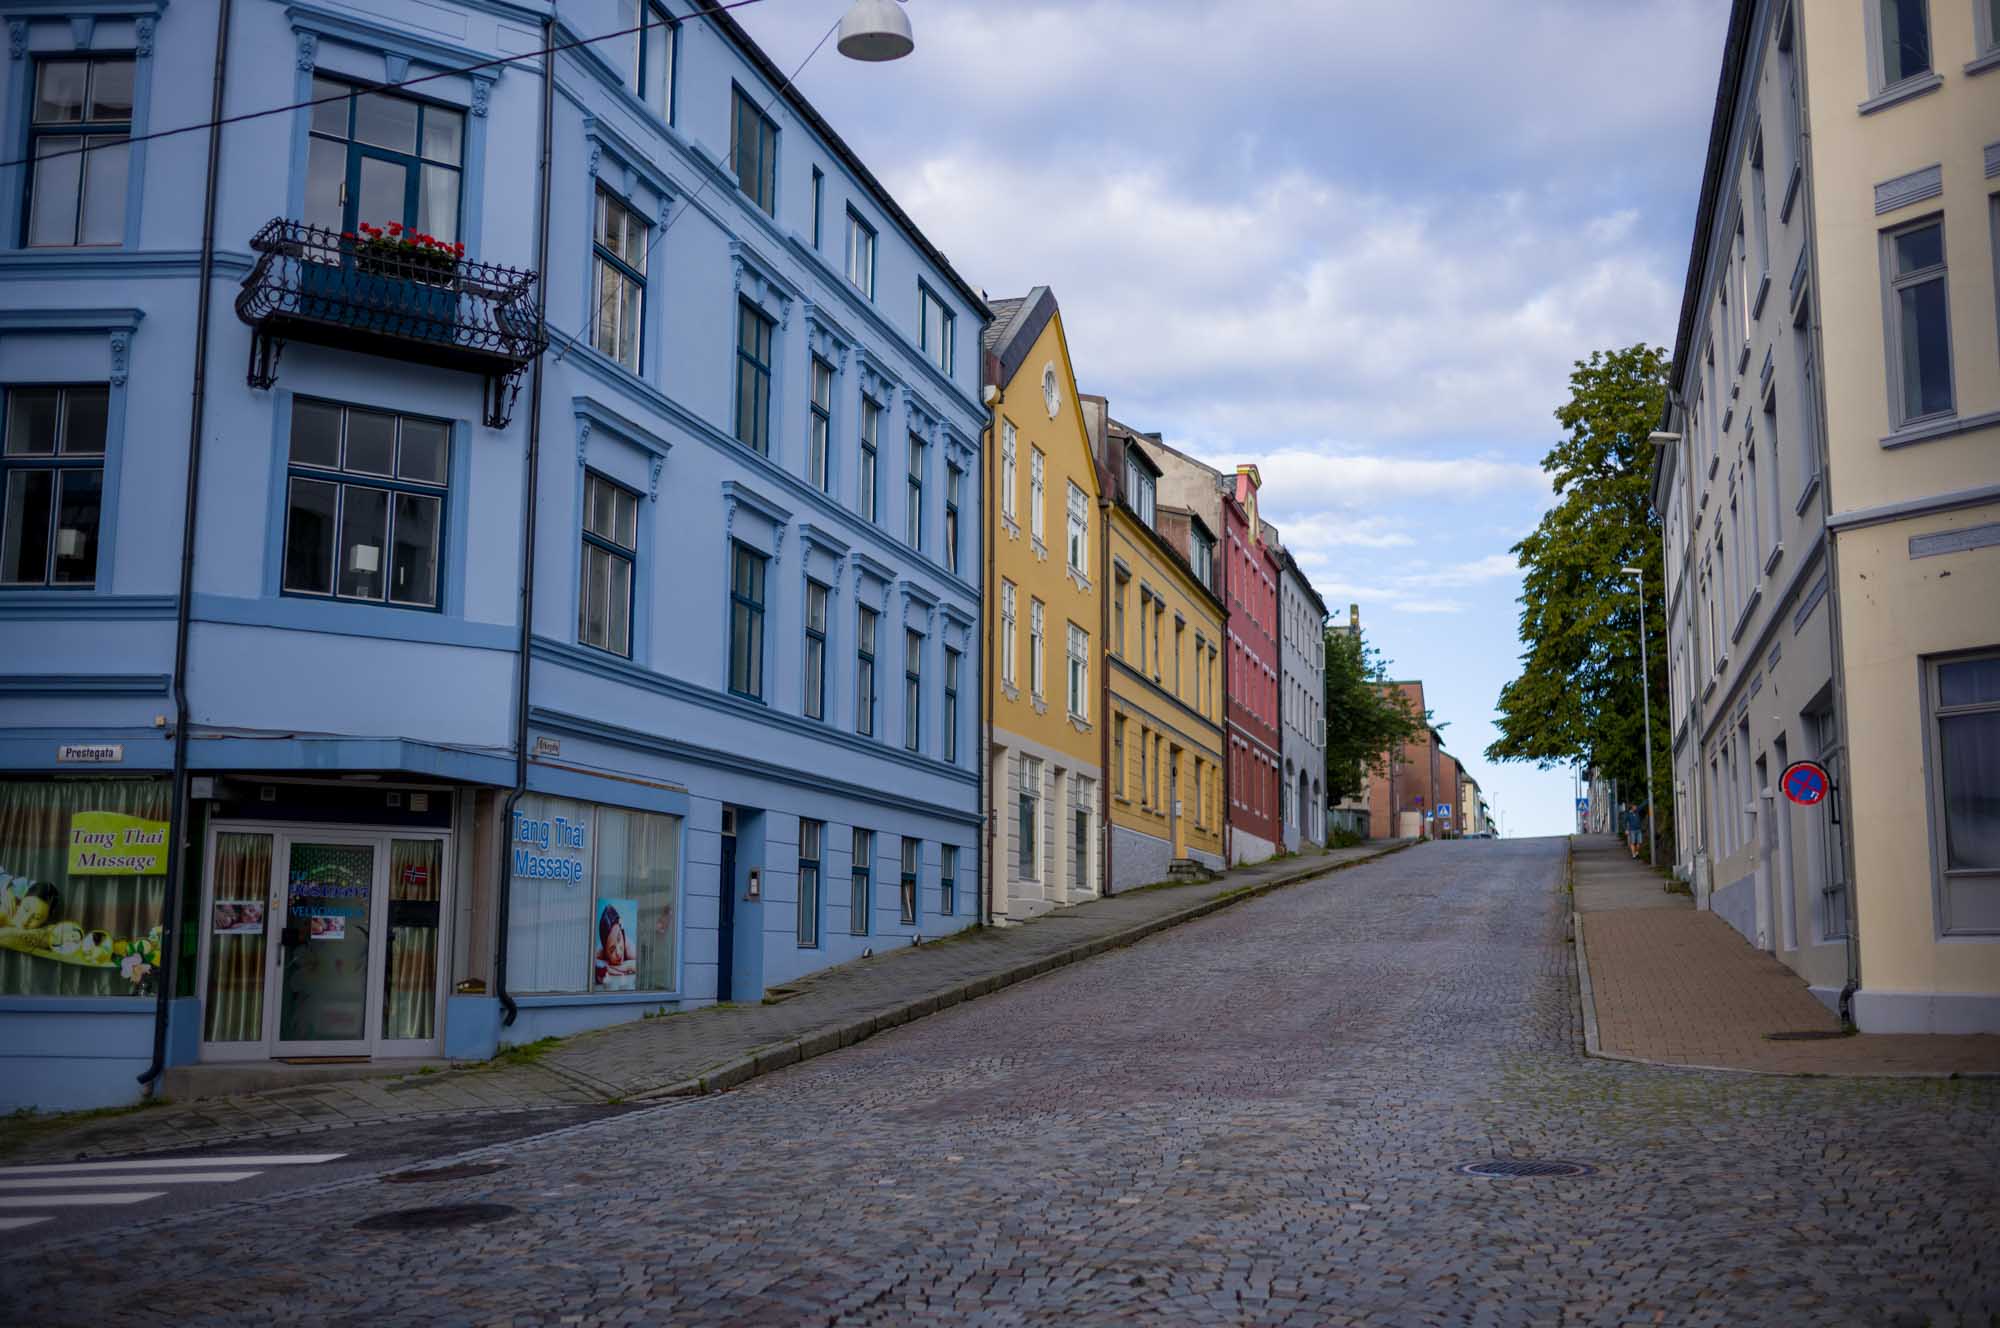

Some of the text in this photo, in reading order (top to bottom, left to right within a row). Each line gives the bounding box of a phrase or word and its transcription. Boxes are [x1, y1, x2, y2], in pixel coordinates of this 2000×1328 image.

[66, 748, 114, 760] Prestegata
[72, 828, 165, 848] Tang Thai
[512, 811, 585, 850] Tang Thai
[77, 852, 156, 870] Massage
[514, 849, 583, 886] Massasje
